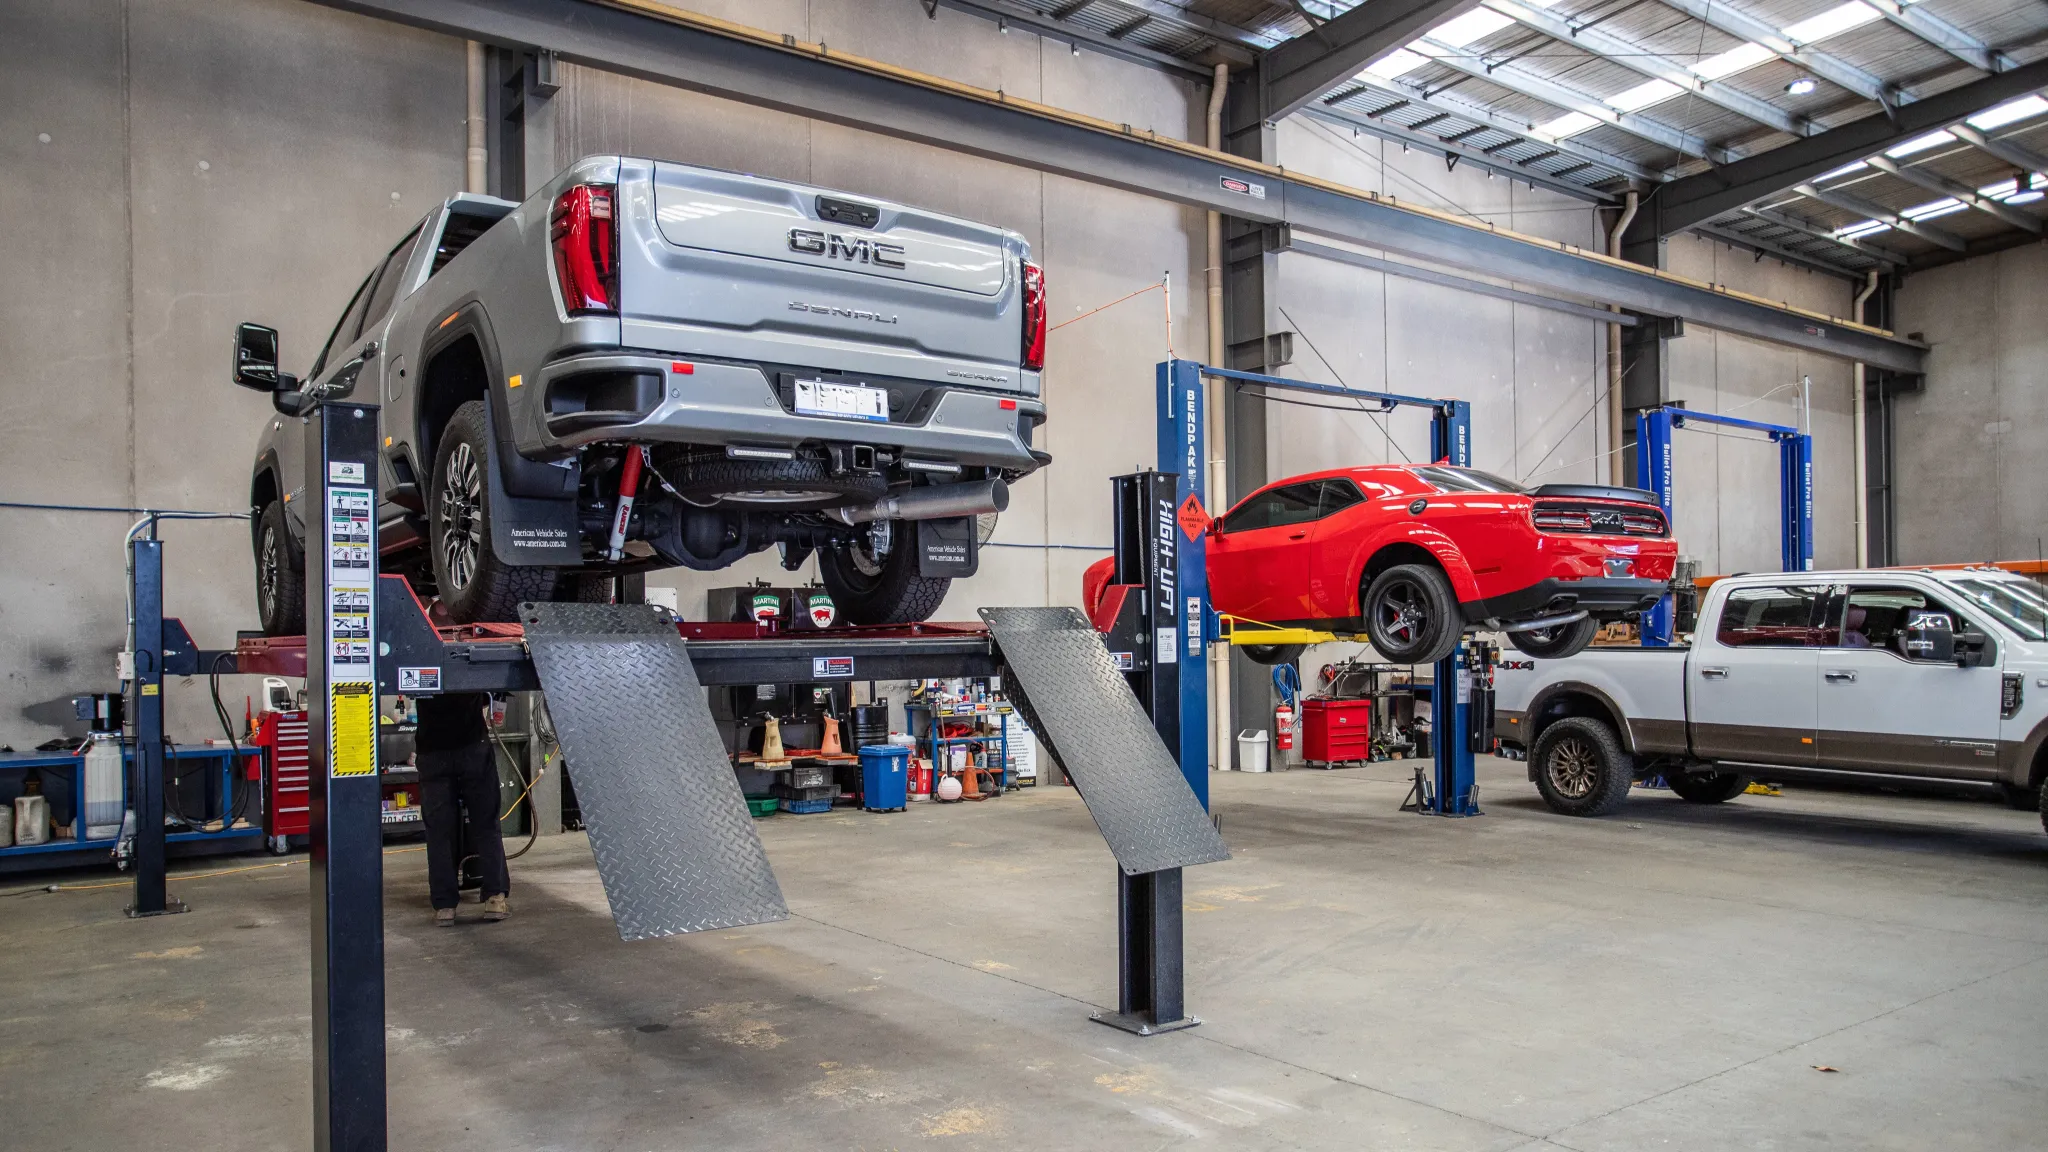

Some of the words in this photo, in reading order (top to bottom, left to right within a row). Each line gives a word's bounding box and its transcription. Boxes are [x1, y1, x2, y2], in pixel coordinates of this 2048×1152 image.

[787, 228, 906, 270] GMC
[788, 301, 898, 324] DENALI
[1187, 389, 1196, 467] BENDPAK
[1663, 443, 1671, 469] Bullet
[511, 529, 535, 537] American
[535, 529, 554, 537] Vehicle
[554, 529, 568, 537] Sales
[754, 597, 779, 606] MARTINI
[810, 597, 834, 606] MARTIN
